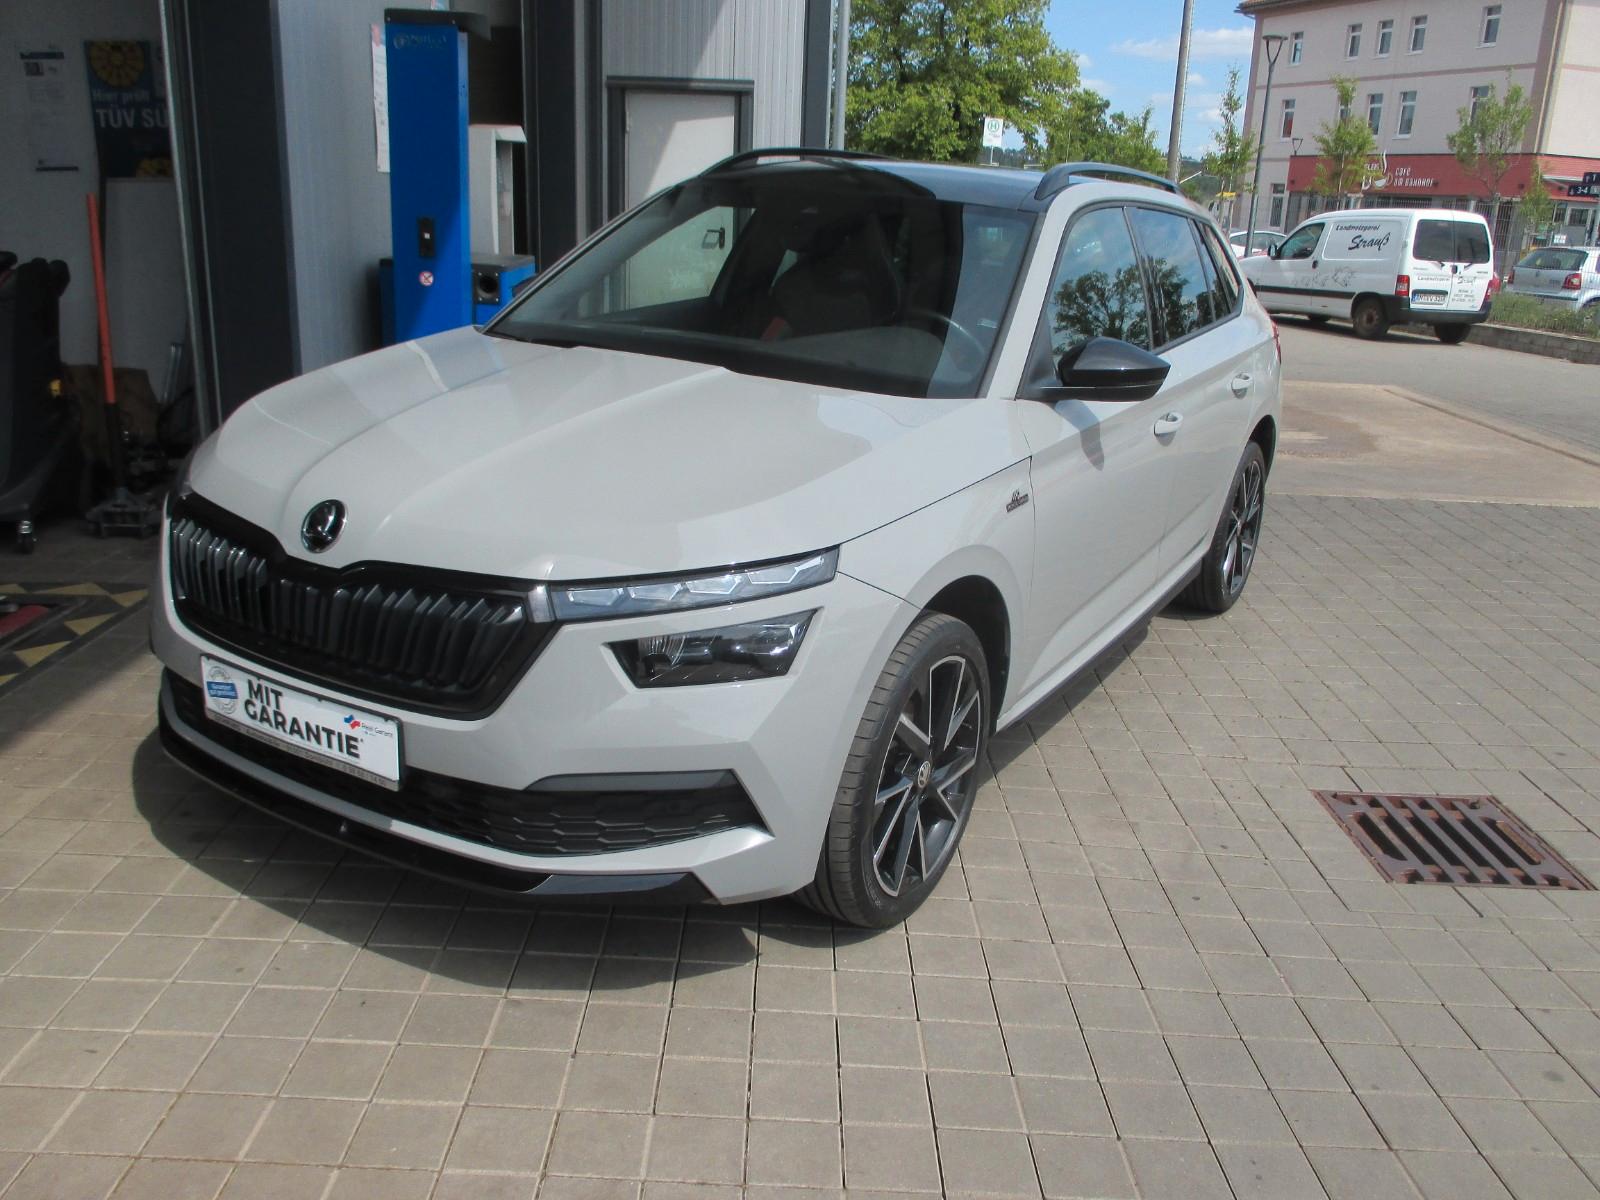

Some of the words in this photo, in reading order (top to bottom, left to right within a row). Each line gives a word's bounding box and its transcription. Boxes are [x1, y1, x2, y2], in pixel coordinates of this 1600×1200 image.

[95, 104, 136, 128] TÜV
[142, 104, 170, 129] SÜ
[1348, 232, 1391, 251] Strauß
[248, 678, 283, 710] MIT
